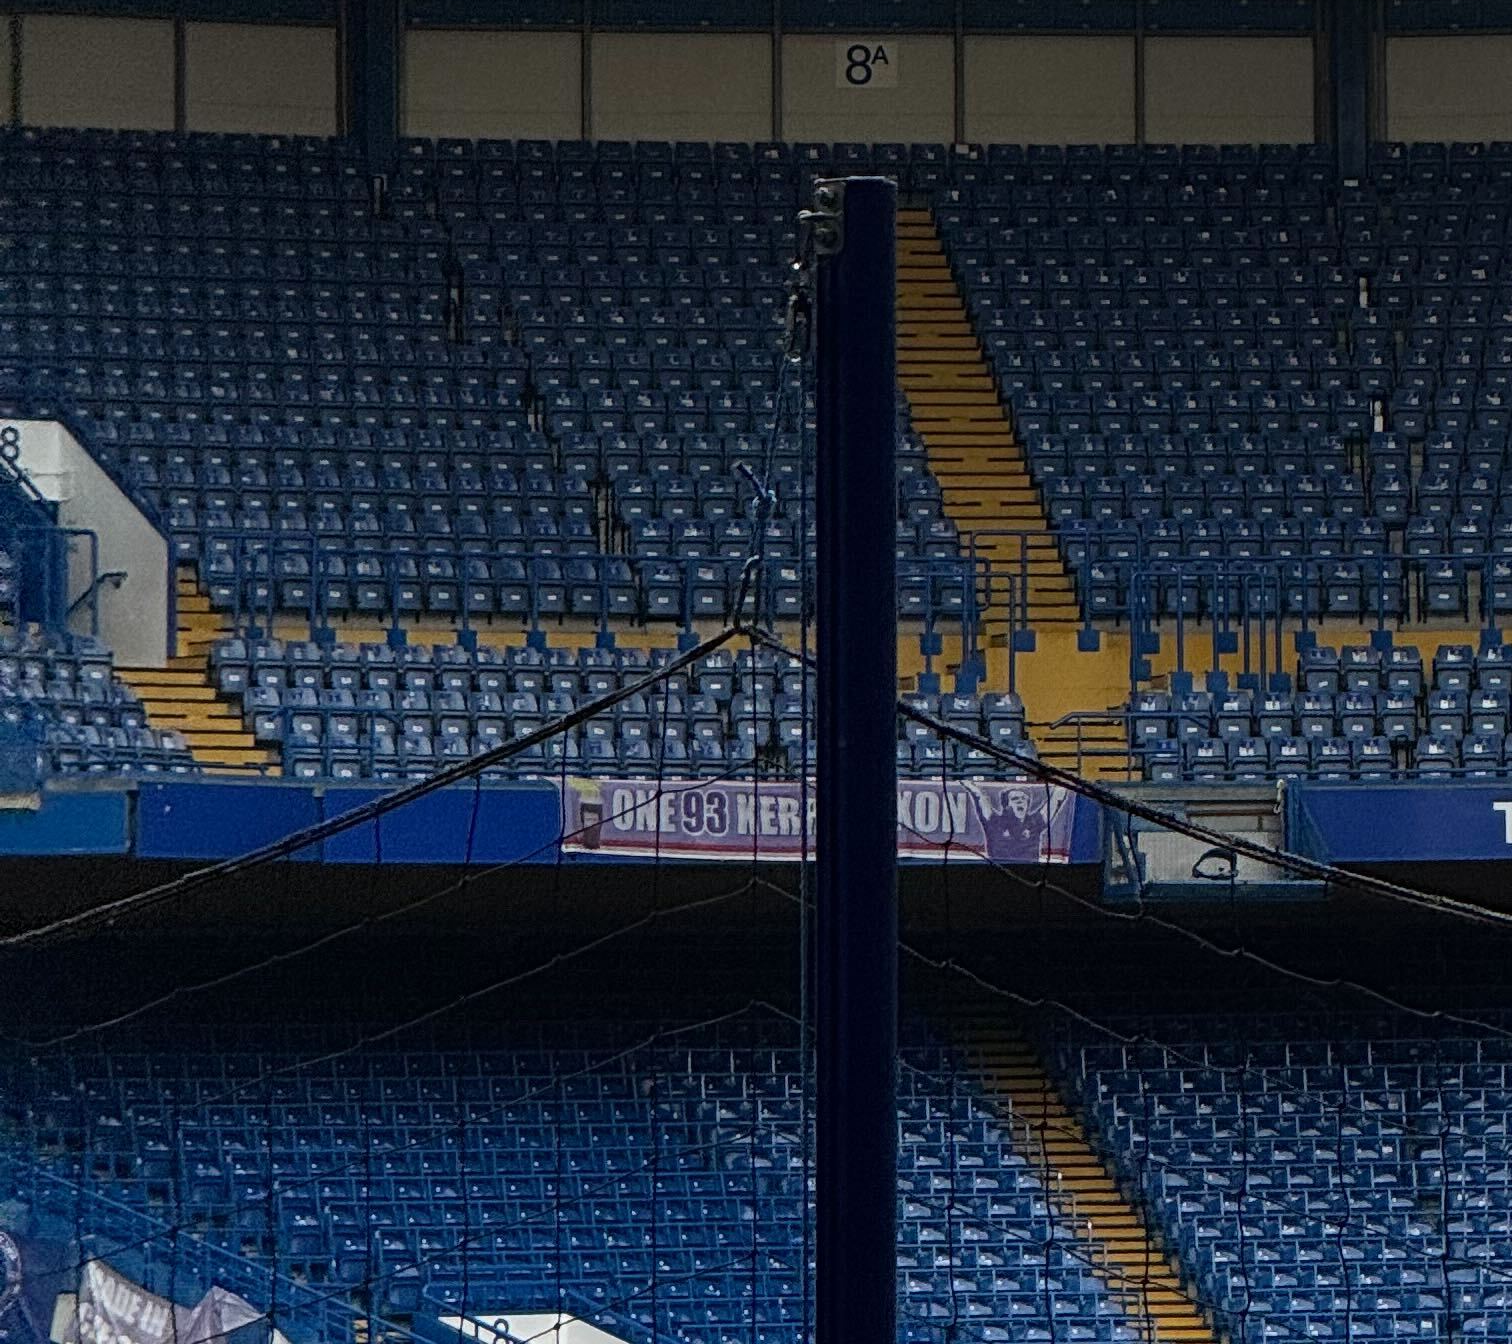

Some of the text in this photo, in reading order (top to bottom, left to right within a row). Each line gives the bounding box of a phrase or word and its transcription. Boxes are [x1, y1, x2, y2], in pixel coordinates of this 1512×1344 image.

[0, 426, 19, 461] 8
[612, 788, 676, 832] ONE
[681, 789, 729, 836] 93
